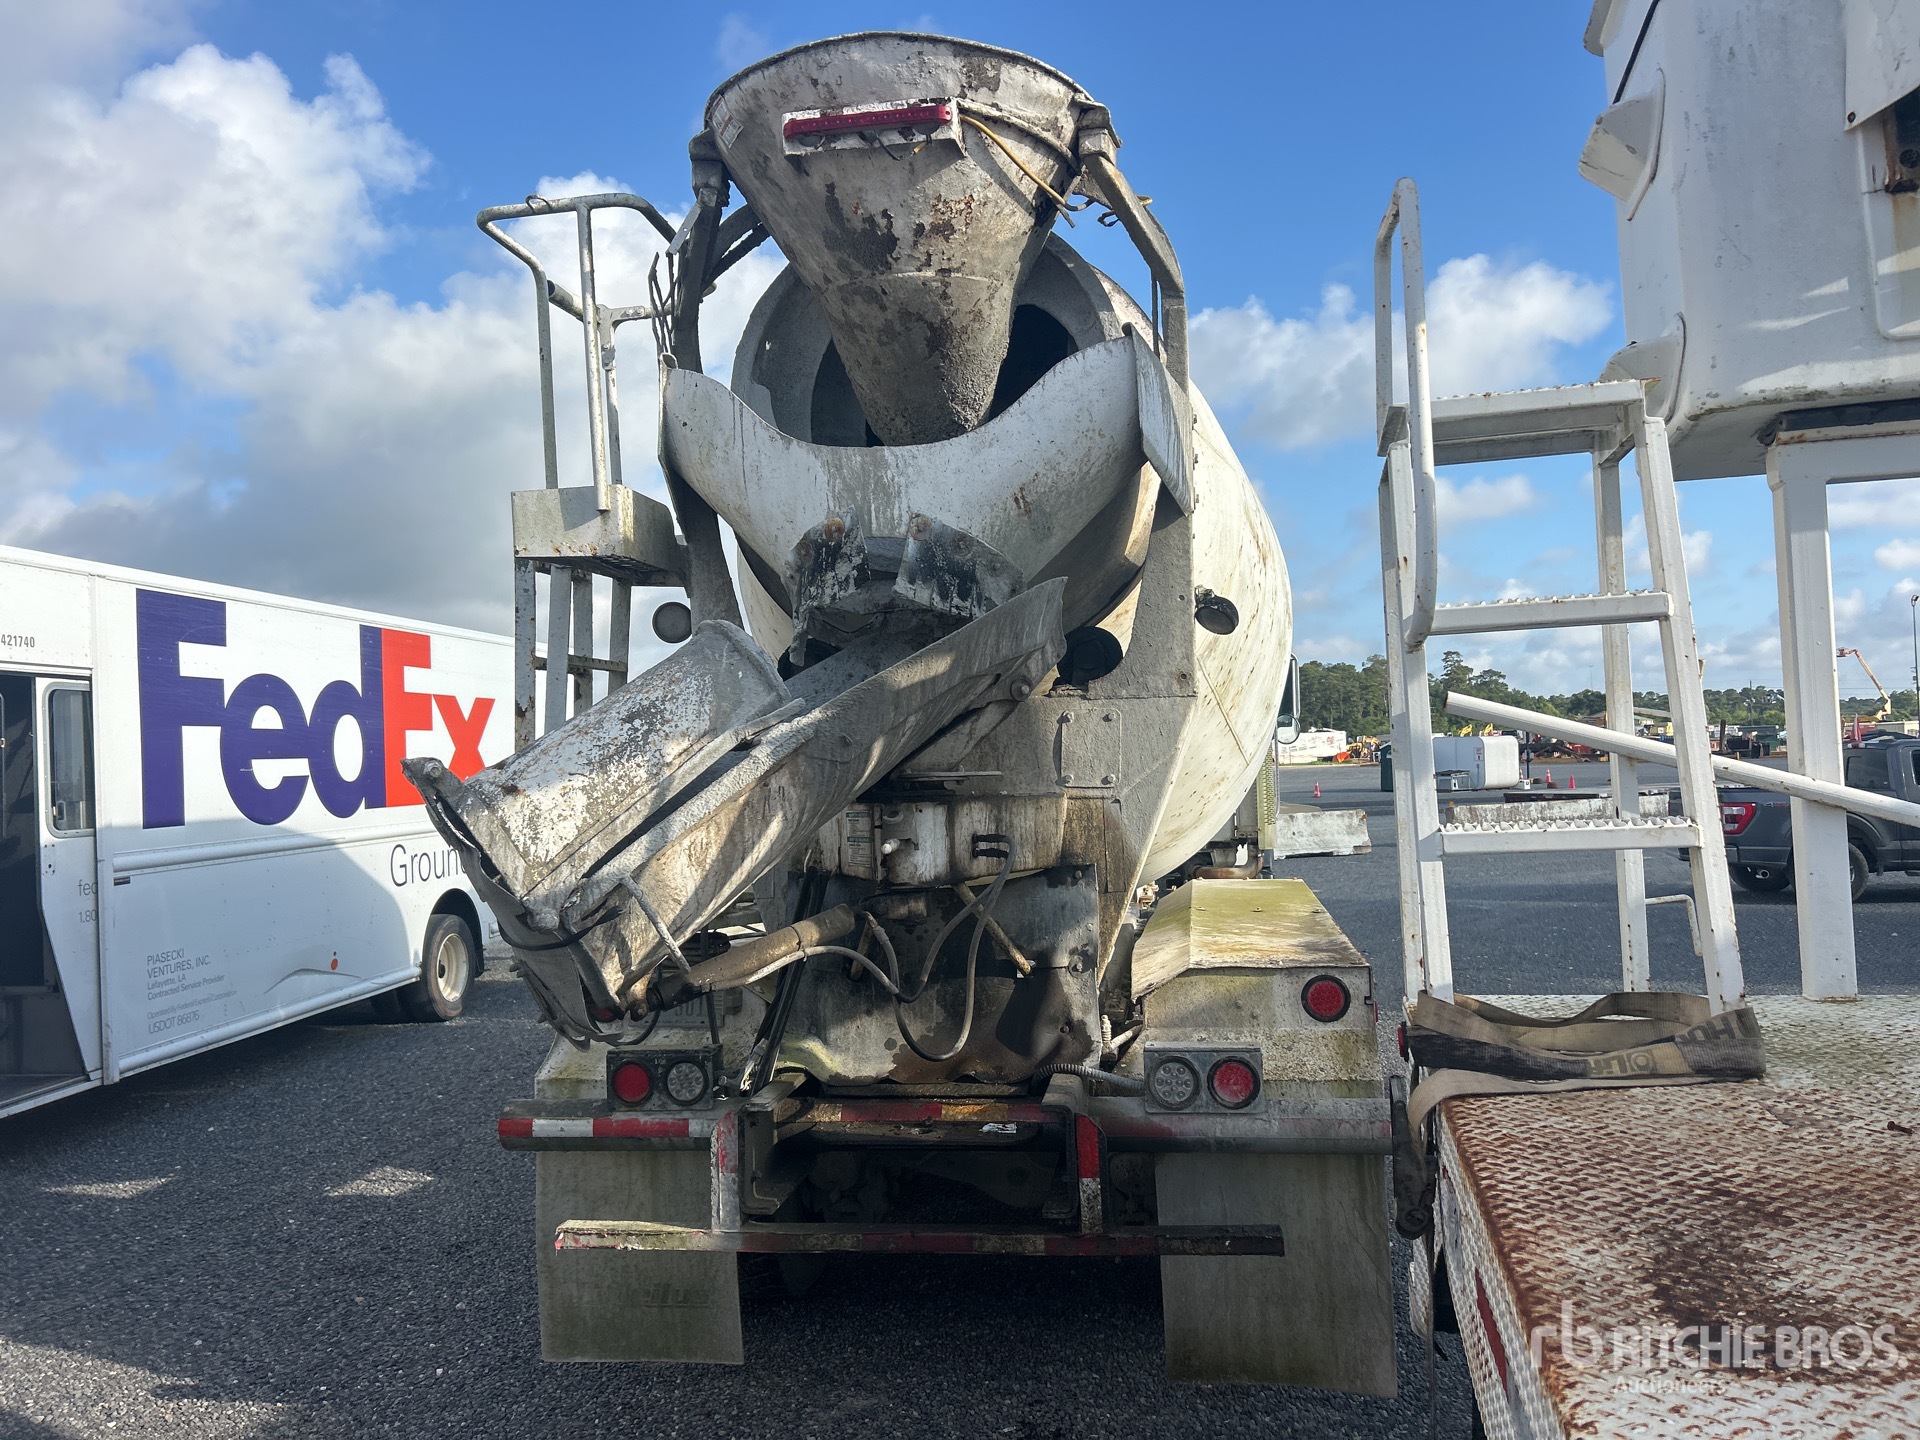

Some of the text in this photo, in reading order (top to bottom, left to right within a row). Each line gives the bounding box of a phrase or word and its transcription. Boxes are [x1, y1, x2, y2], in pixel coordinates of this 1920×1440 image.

[0, 633, 35, 648] 421740
[136, 588, 496, 830] FedEx
[390, 843, 466, 888] Groun
[147, 948, 185, 966] PIASECKI
[147, 955, 212, 979] VENTURES, INC.
[148, 975, 225, 1001] Contracted Service Provider
[178, 974, 187, 983] LA
[149, 1017, 176, 1034] USDOT
